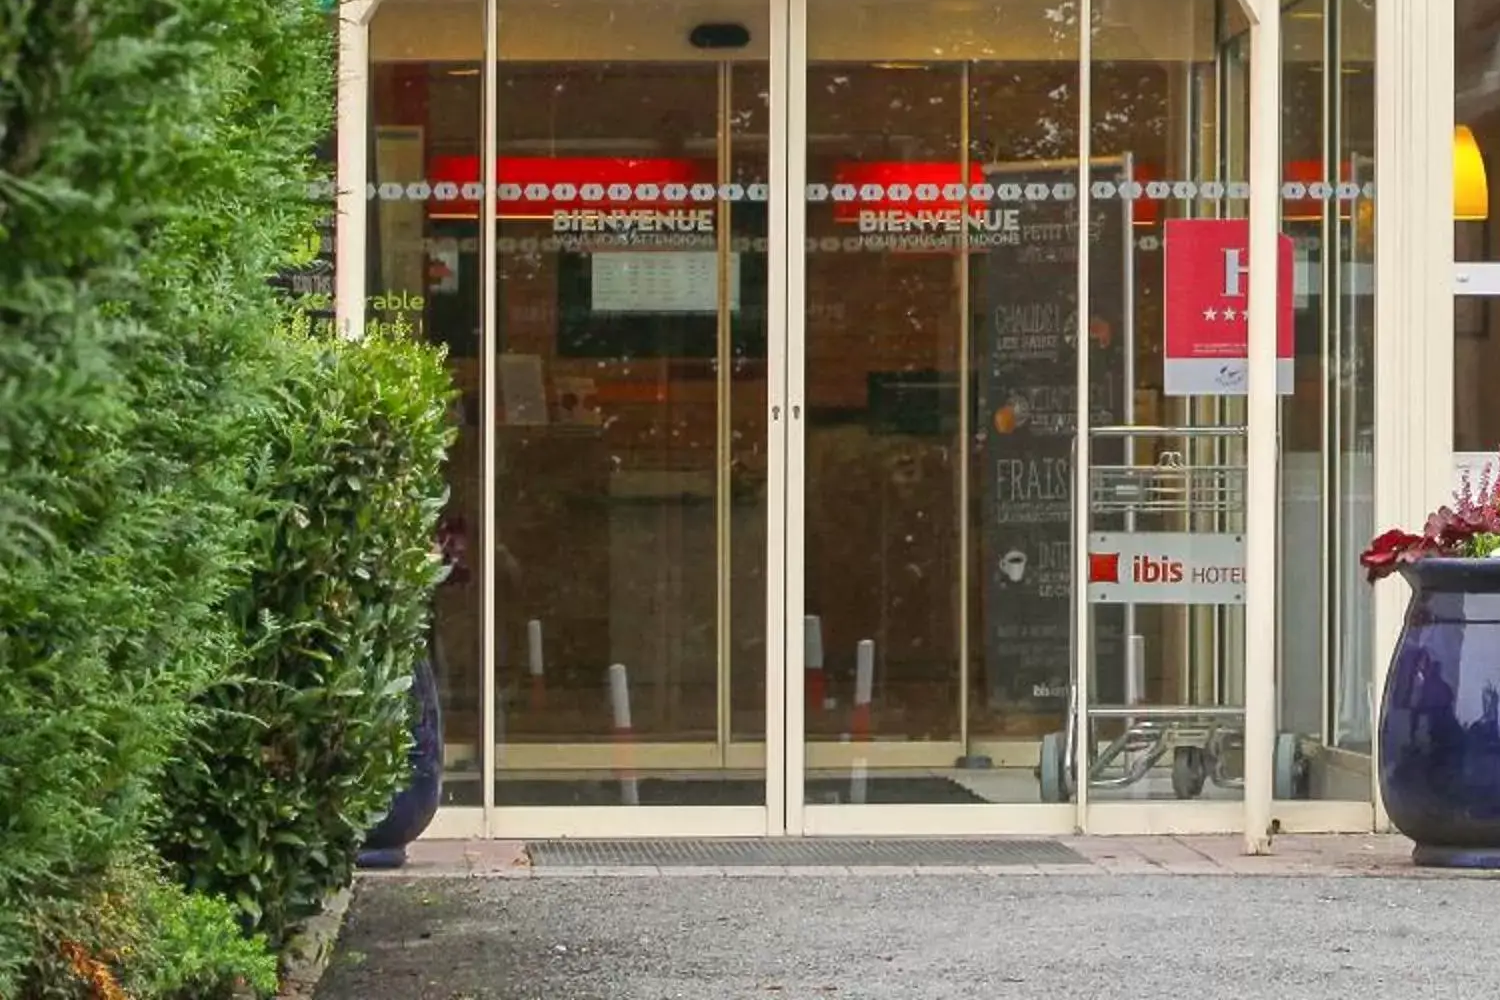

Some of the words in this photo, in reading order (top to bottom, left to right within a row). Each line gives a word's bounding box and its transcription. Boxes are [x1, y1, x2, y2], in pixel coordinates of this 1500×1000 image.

[553, 209, 714, 232] BIENVENUE
[859, 209, 1020, 232] BIENVENUE
[1132, 555, 1184, 584] ibis
